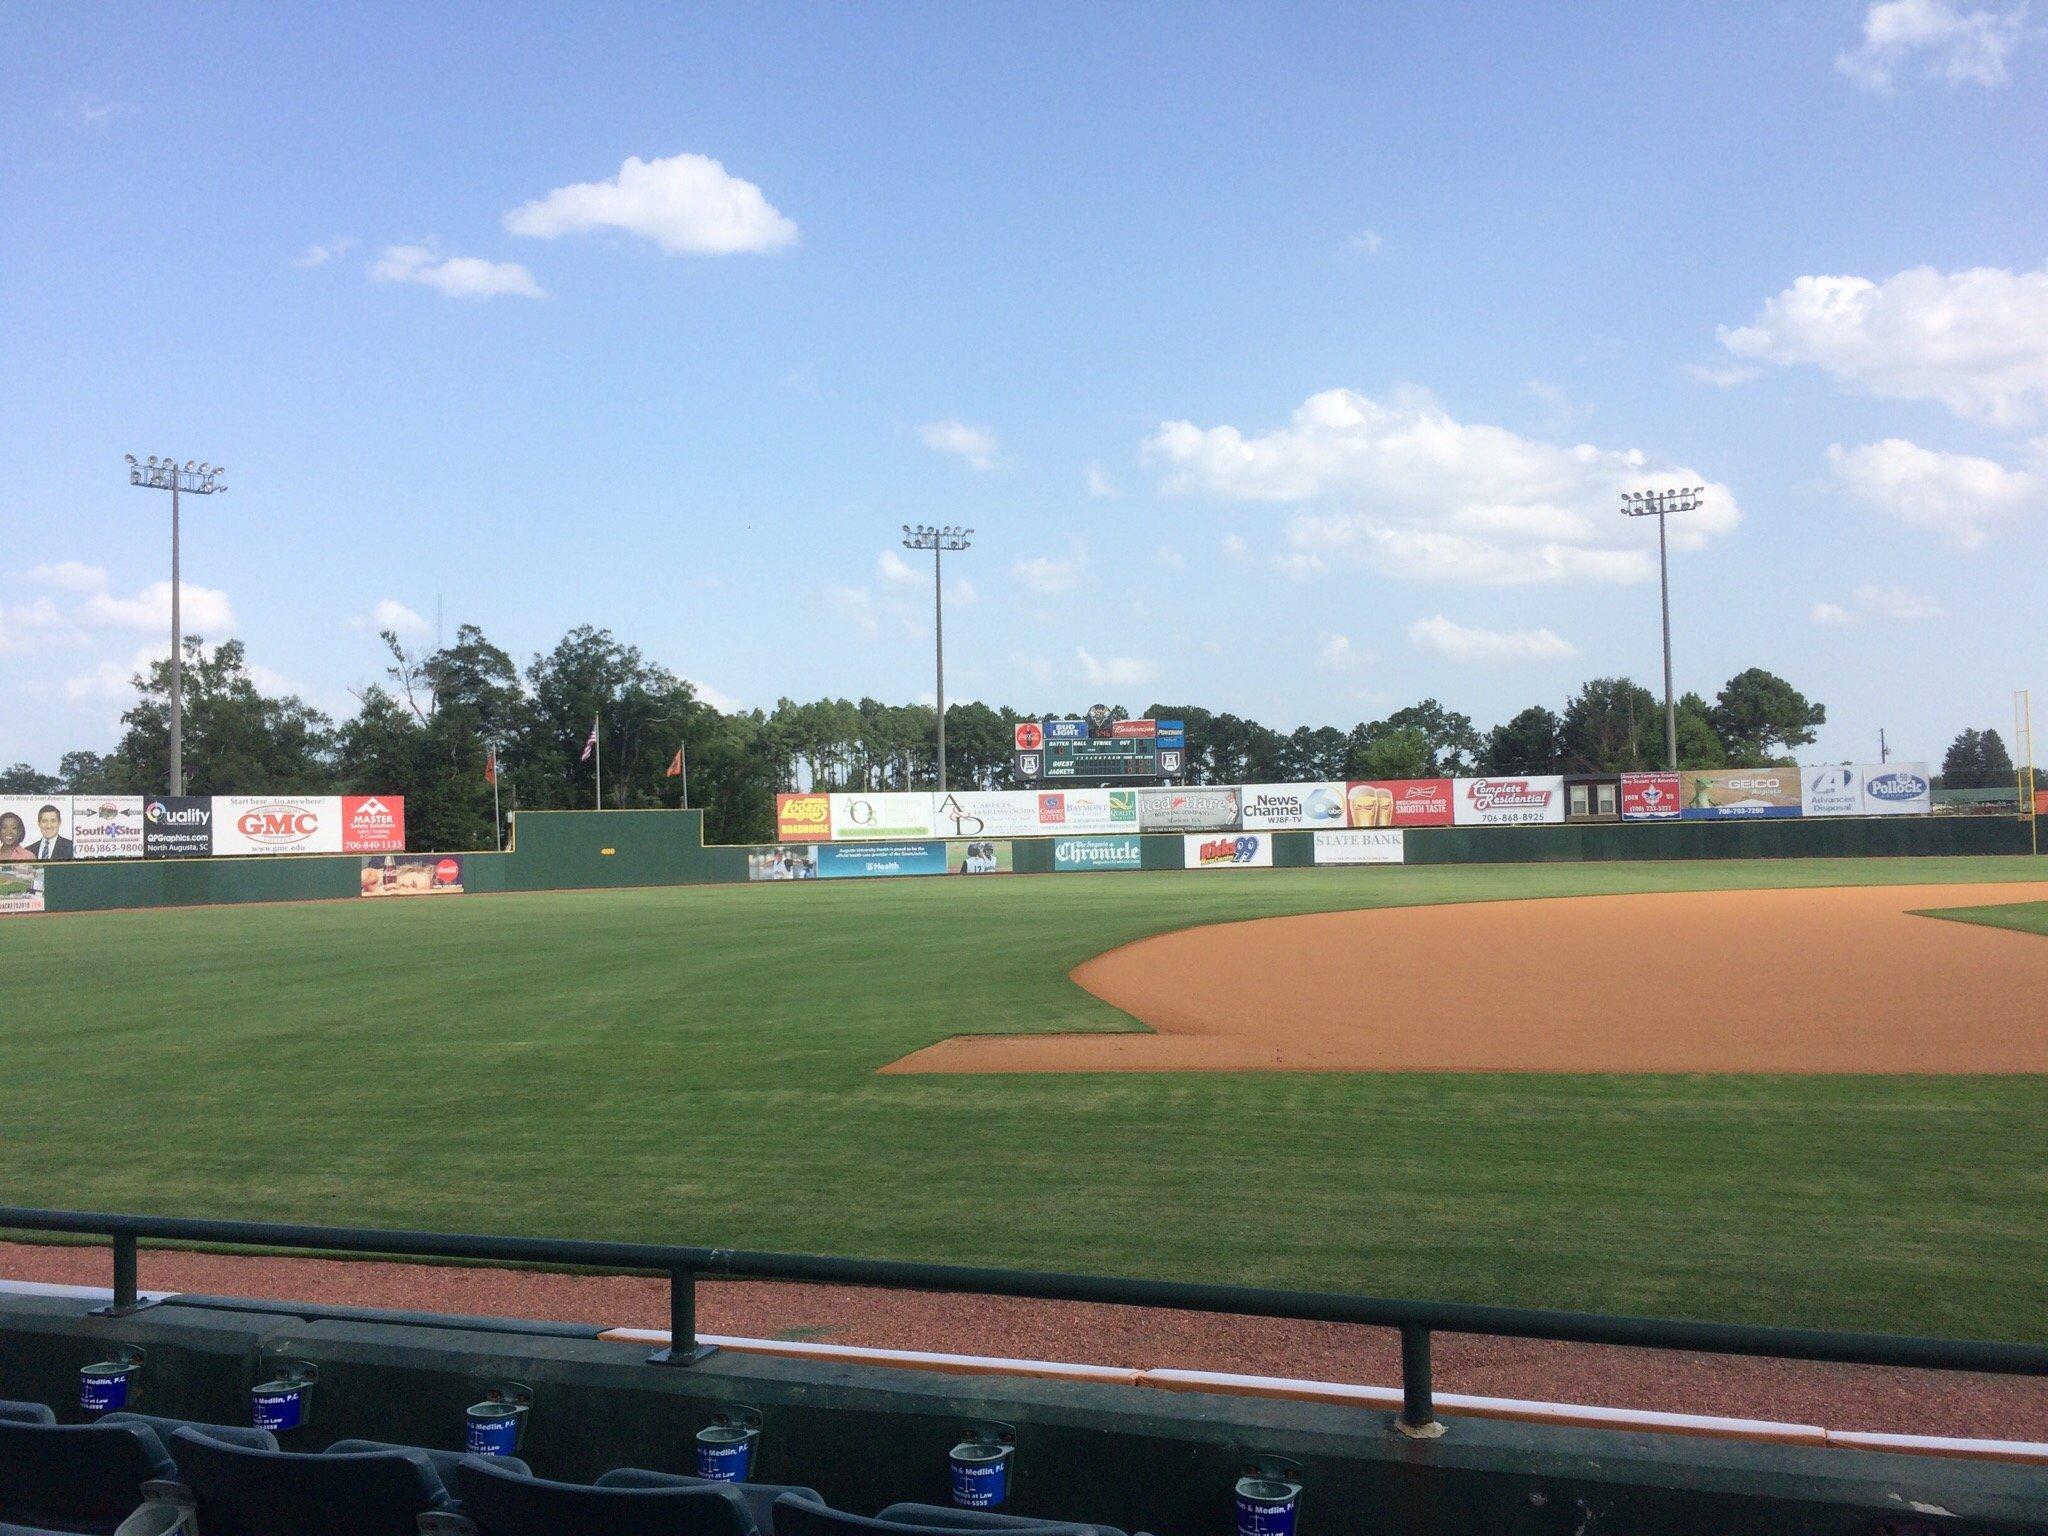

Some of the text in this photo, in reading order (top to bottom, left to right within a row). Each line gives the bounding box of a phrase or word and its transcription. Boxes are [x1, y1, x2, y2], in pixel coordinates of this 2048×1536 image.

[1473, 780, 1522, 797] Complete
[1728, 779, 1780, 789] GEICO
[1872, 780, 1922, 794] Pollock
[230, 797, 248, 805] Start
[287, 797, 325, 805] anywhere!
[1140, 795, 1227, 813] Red Hare
[1257, 795, 1299, 806] News
[1476, 793, 1546, 810] Residential
[1066, 803, 1107, 812] BAYMONT
[1243, 804, 1302, 817] Channel
[1395, 804, 1448, 813] SMOOTH TASTE
[1814, 804, 1851, 812] Disposal
[354, 815, 393, 823] MASTER
[1482, 813, 1544, 822] 706-868-8925
[237, 813, 318, 836] GMC
[782, 824, 829, 834] ROADHOUSE
[75, 826, 142, 836] South Star
[147, 834, 208, 843] QPGraphics.com
[1316, 833, 1402, 846] STATE BANK
[74, 843, 144, 853] (706)863-9800
[147, 843, 209, 852] North Augusta, SC
[1055, 841, 1140, 863] Chronicle
[1200, 836, 1259, 863] Kicks 99
[874, 862, 900, 870] Health
[476, 1423, 504, 1431] Medlin,
[709, 1449, 738, 1457] Medlin,
[965, 1468, 995, 1476] Medlin,
[1255, 1506, 1287, 1515] Medlin,
